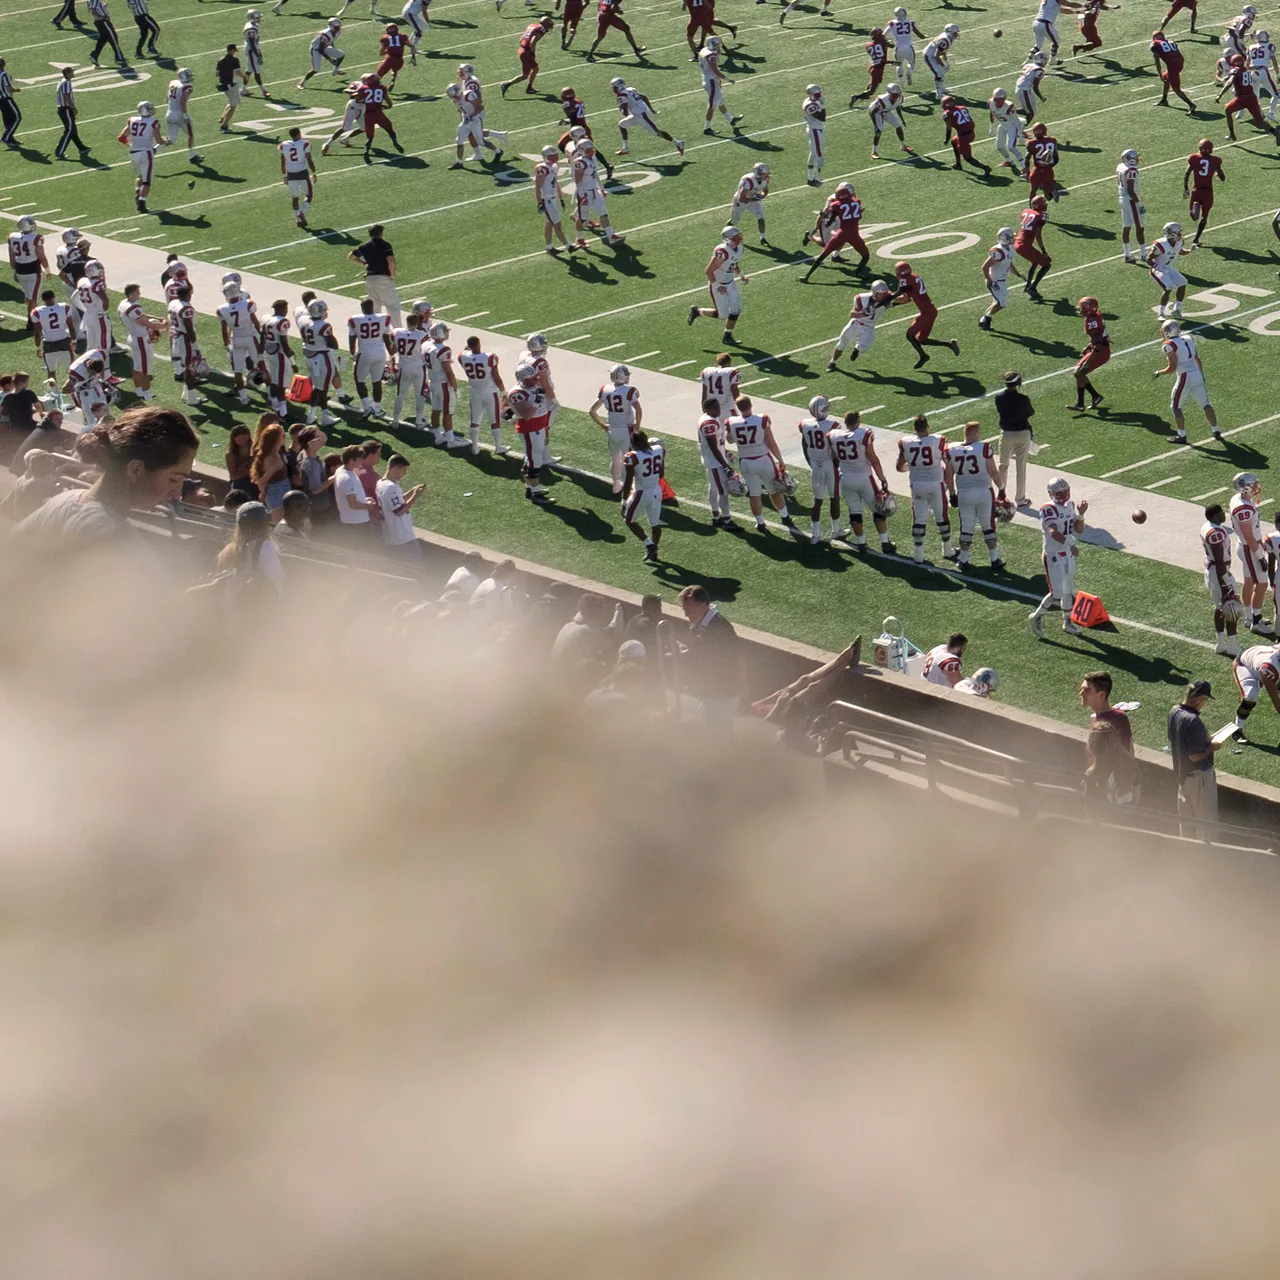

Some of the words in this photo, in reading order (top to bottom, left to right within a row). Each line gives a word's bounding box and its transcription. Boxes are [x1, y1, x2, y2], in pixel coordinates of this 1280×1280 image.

[387, 35, 402, 47] 11
[364, 88, 383, 102] 28
[130, 122, 147, 136] 97
[290, 148, 298, 162] 2
[1198, 159, 1210, 176] 3
[840, 202, 860, 219] 22
[13, 243, 31, 256] 34
[50, 314, 58, 328] 2
[232, 313, 239, 326] 7
[360, 323, 381, 338] 92
[398, 339, 416, 354] 87
[465, 363, 486, 378] 26
[708, 379, 724, 394] 14
[606, 396, 622, 412] 12
[736, 426, 757, 442] 57
[808, 432, 824, 449] 18
[836, 440, 859, 460] 63
[909, 446, 933, 467] 79
[642, 459, 660, 477] 36
[954, 455, 980, 474] 73
[1073, 597, 1094, 623] 40
